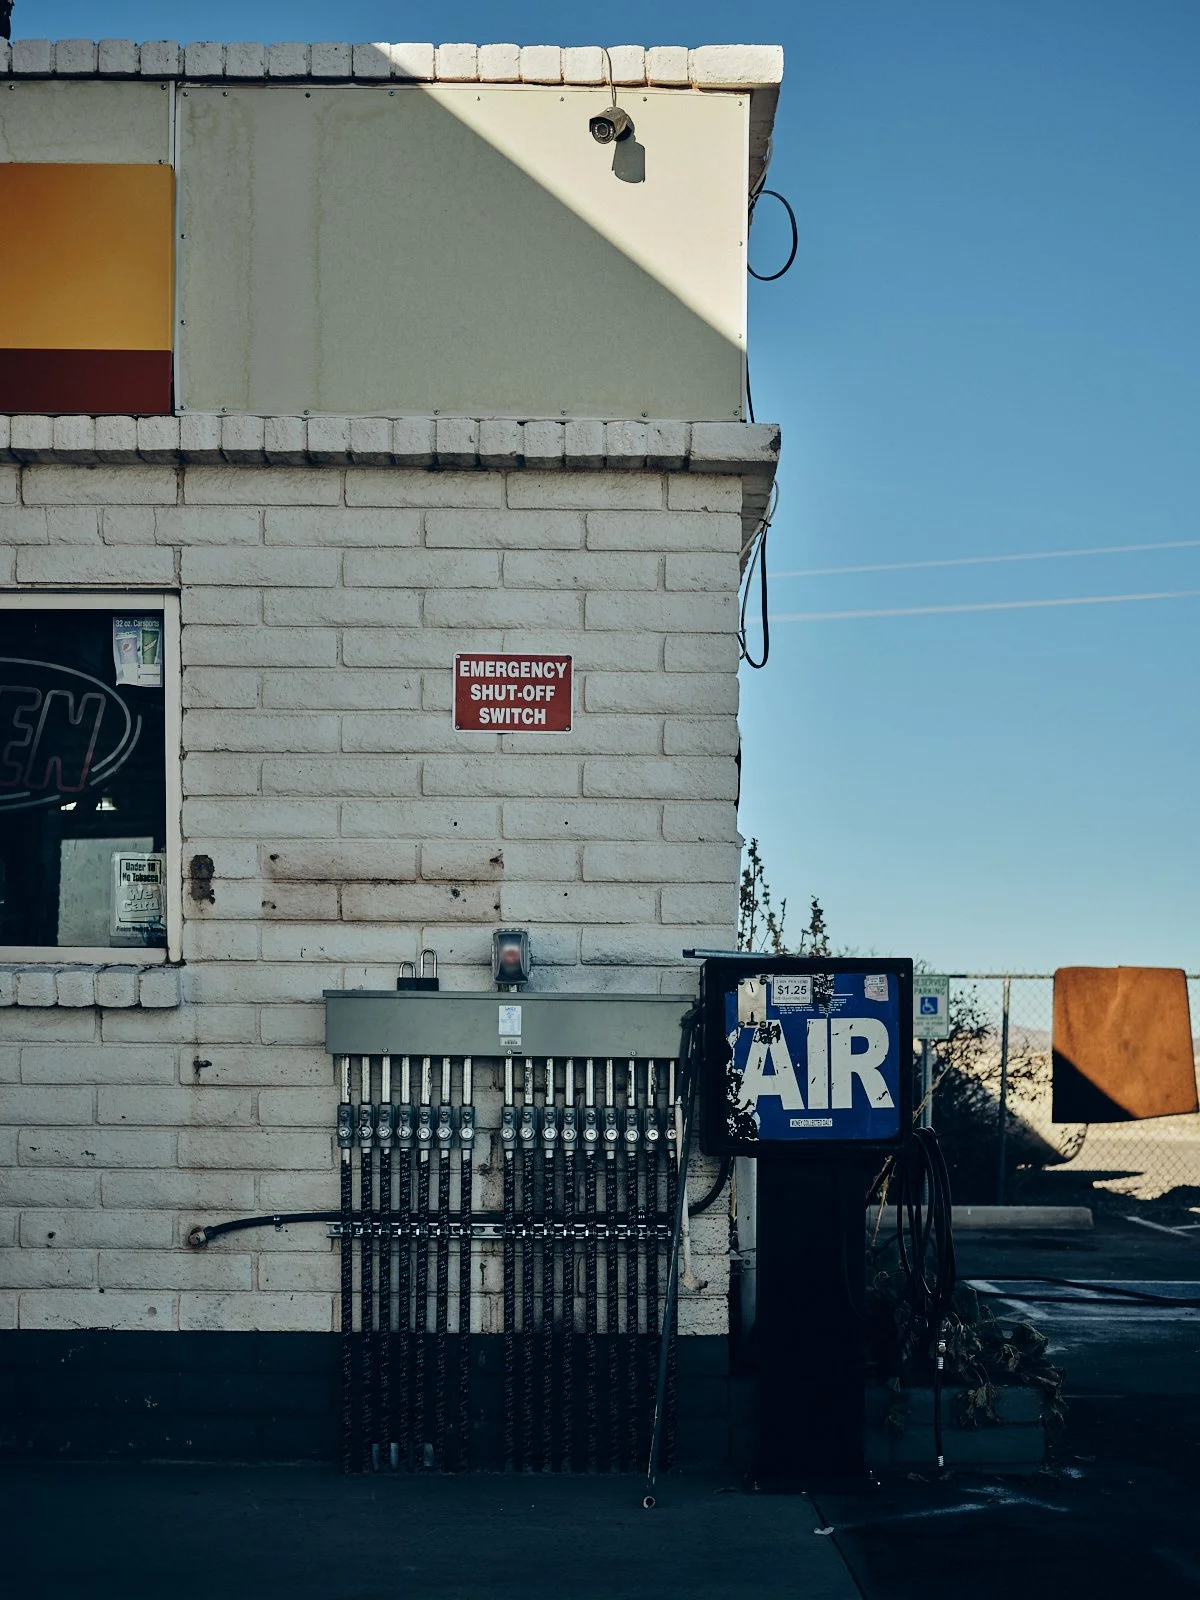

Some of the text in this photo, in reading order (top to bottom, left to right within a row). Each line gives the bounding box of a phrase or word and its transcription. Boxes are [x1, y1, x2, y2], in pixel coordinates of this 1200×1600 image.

[460, 661, 567, 678] EMERGENCY
[470, 684, 555, 701] SHUT-OFF
[479, 707, 546, 725] SWITCH
[125, 862, 156, 871] Under 18
[122, 872, 159, 882] No Tobacco
[127, 888, 154, 901] We
[122, 899, 160, 912] Card
[777, 985, 807, 995] $1.25
[914, 987, 945, 995] PARKING
[737, 1018, 895, 1110] AIR
